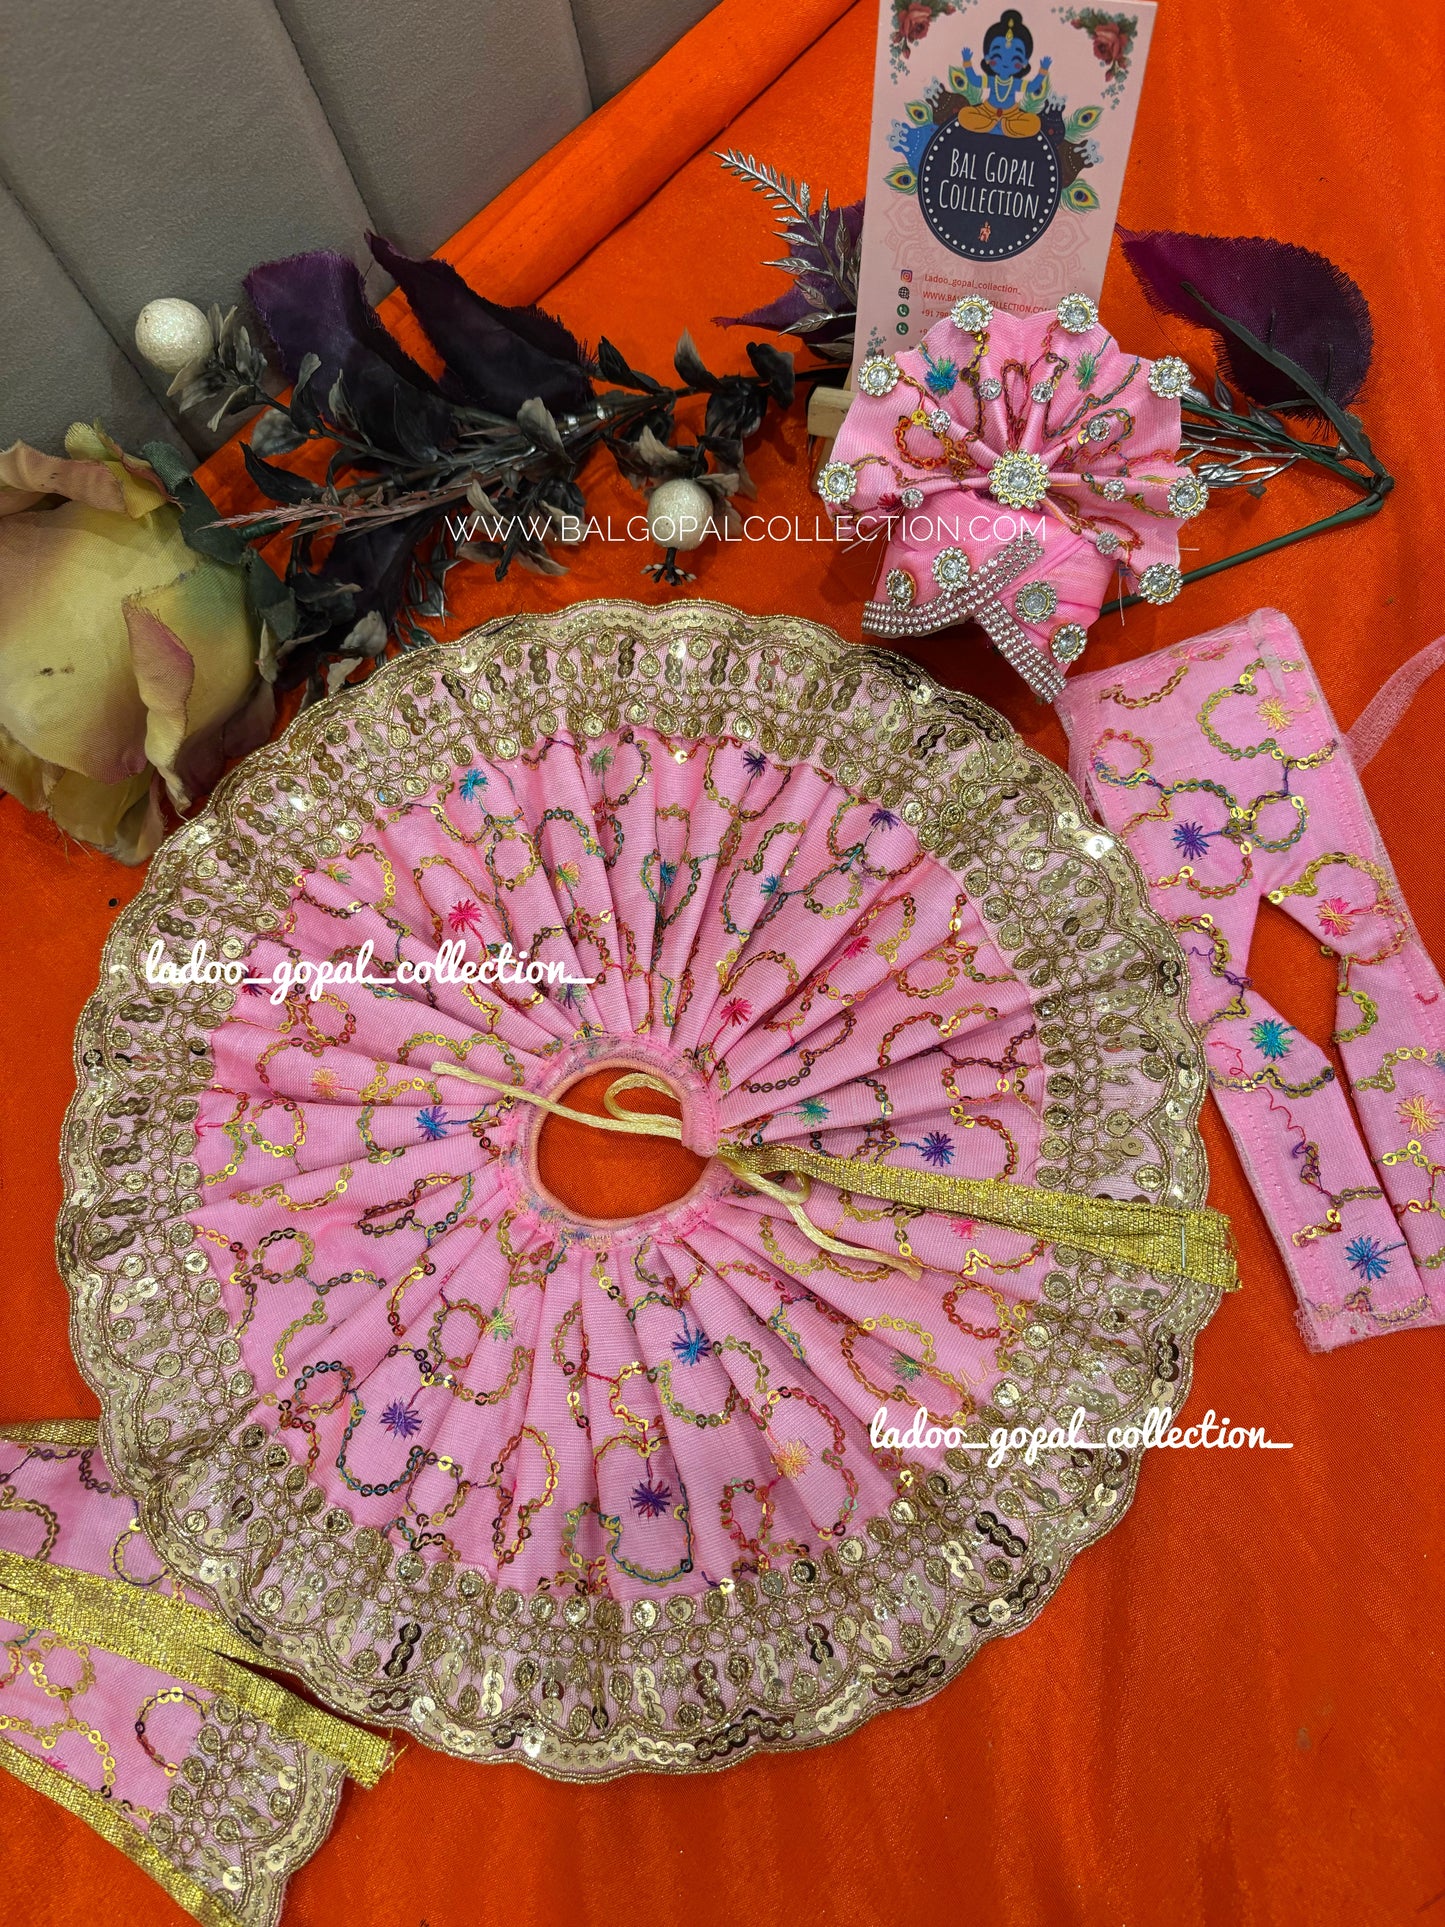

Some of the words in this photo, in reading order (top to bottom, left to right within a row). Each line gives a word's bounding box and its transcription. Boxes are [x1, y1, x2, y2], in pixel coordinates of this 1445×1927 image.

[950, 148, 977, 180] BAL
[985, 151, 1035, 187] GOPAL
[939, 179, 1040, 219] COLLECTION
